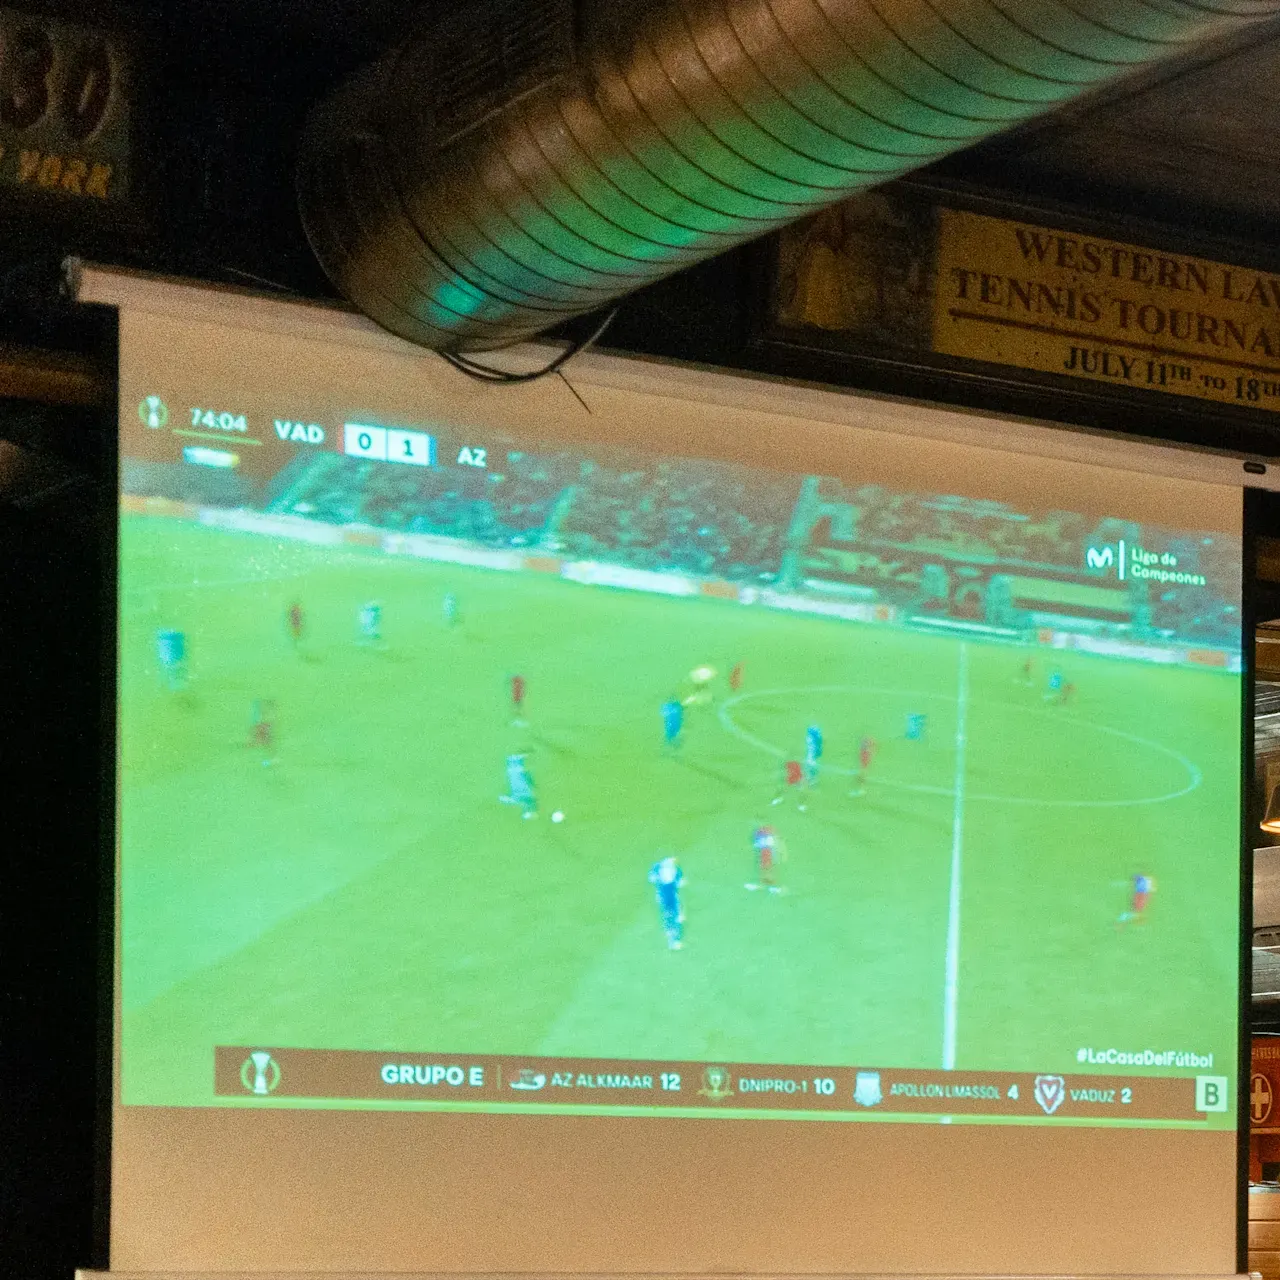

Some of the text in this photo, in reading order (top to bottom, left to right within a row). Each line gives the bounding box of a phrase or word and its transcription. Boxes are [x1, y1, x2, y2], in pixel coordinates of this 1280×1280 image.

[1014, 228, 1210, 295] WESTERN
[949, 266, 1101, 324] TENNIS
[1063, 346, 1137, 381] JULY
[1199, 373, 1227, 391] TO
[189, 407, 488, 468] 74:04 VAD 0 1 AZ
[1130, 563, 1206, 586] Campeones
[1131, 547, 1178, 566] Liga de
[380, 1063, 465, 1087] GRUPO
[469, 1066, 483, 1087] E
[550, 1072, 573, 1088] AZ
[576, 1073, 653, 1090] ALKMAAR
[660, 1073, 681, 1091] 12
[812, 1077, 836, 1095] 10
[1007, 1084, 1019, 1099] 4
[1070, 1088, 1116, 1103] VADUZ
[1121, 1088, 1132, 1103] 2
[1202, 1082, 1220, 1107] B
